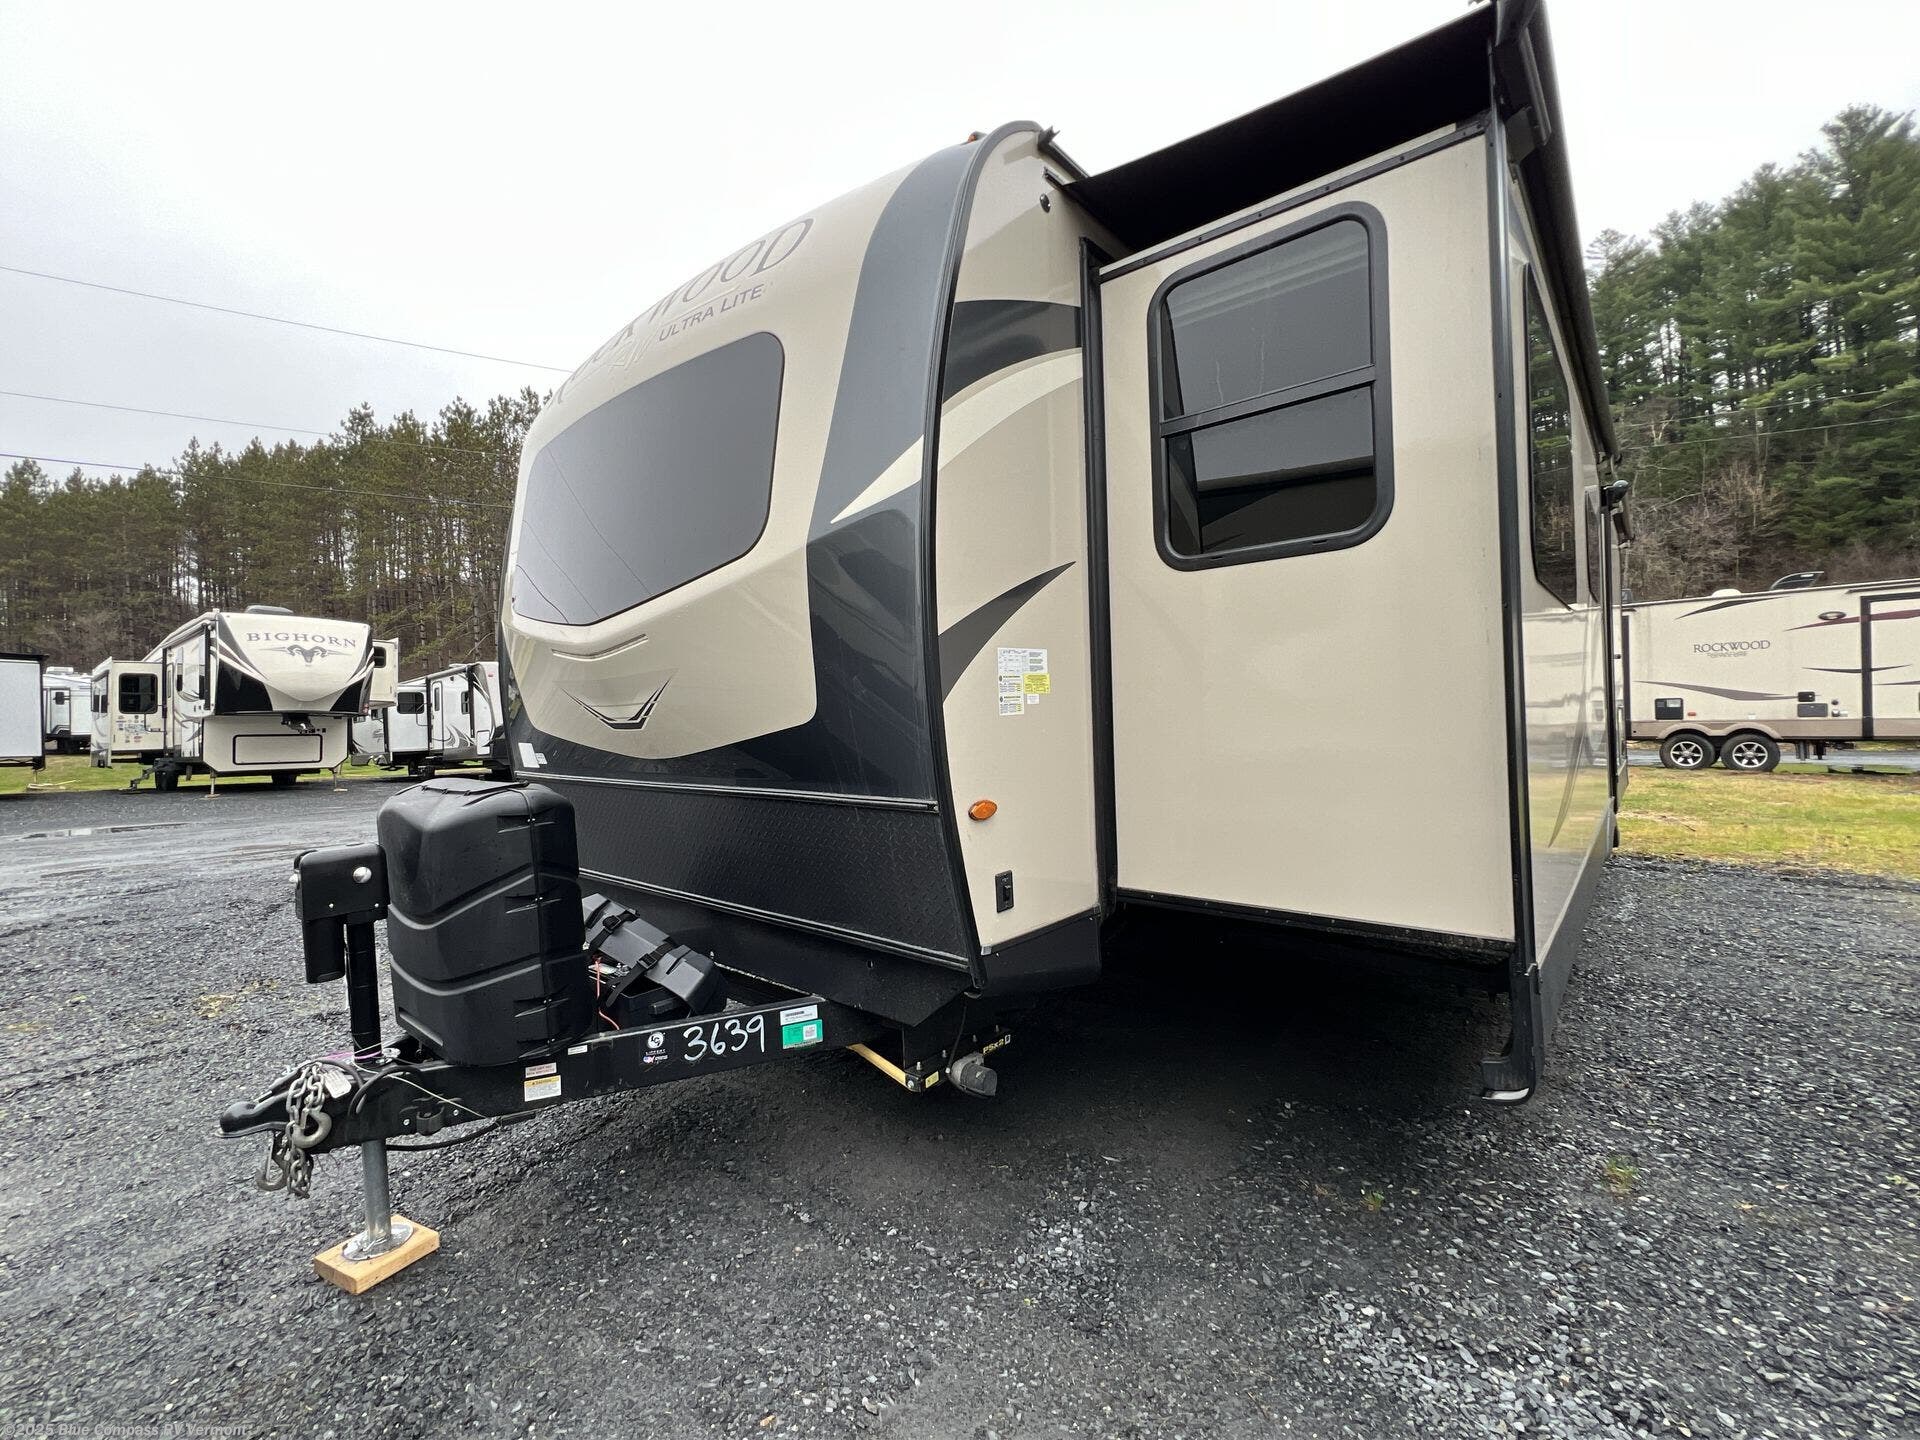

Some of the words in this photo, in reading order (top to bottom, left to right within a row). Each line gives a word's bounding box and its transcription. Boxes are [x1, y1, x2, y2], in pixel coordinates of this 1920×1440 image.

[659, 306, 714, 341] ULTRA
[720, 283, 765, 312] LITE
[246, 632, 356, 648] BIGHORN
[1693, 640, 1771, 653] ROCKWOOD
[682, 1014, 765, 1061] 3639
